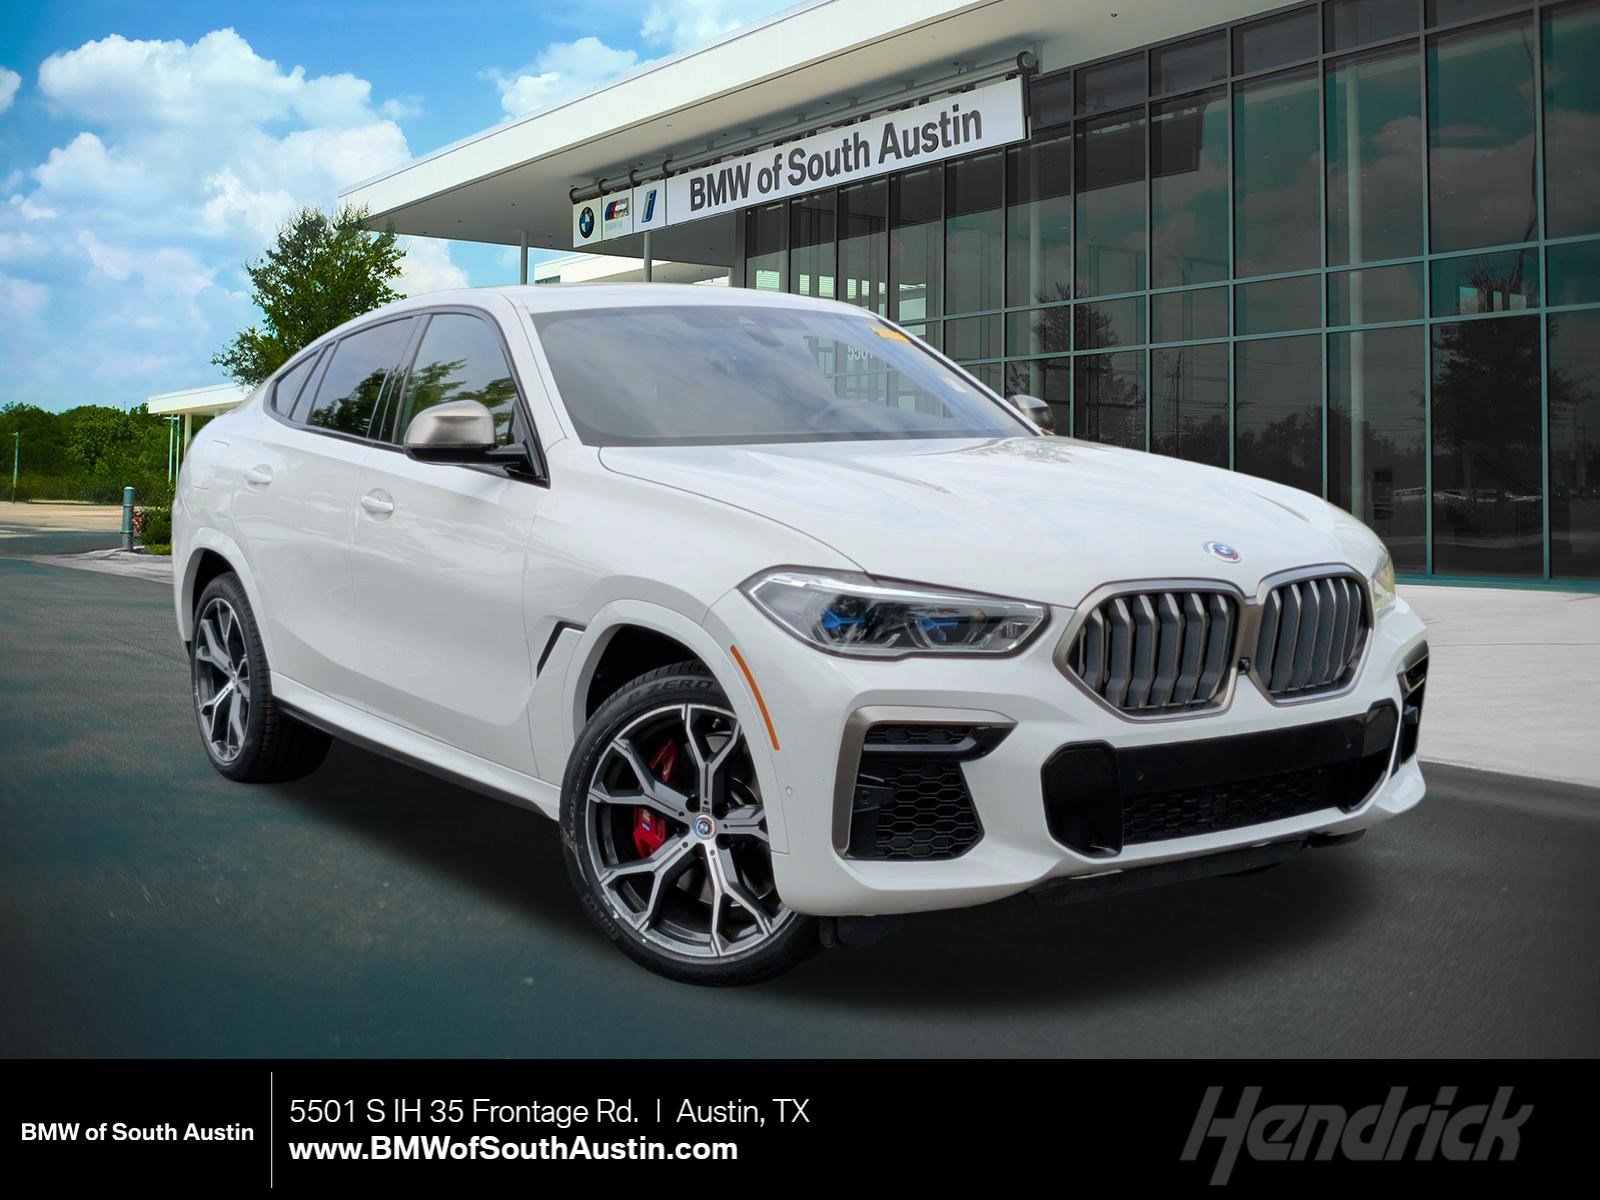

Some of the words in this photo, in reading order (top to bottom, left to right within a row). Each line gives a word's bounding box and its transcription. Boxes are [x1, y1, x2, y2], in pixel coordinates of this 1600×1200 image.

[690, 162, 752, 212] BMW
[757, 153, 783, 194] of
[787, 131, 870, 187] South
[878, 103, 982, 164] Austin
[647, 679, 714, 697] ZERO
